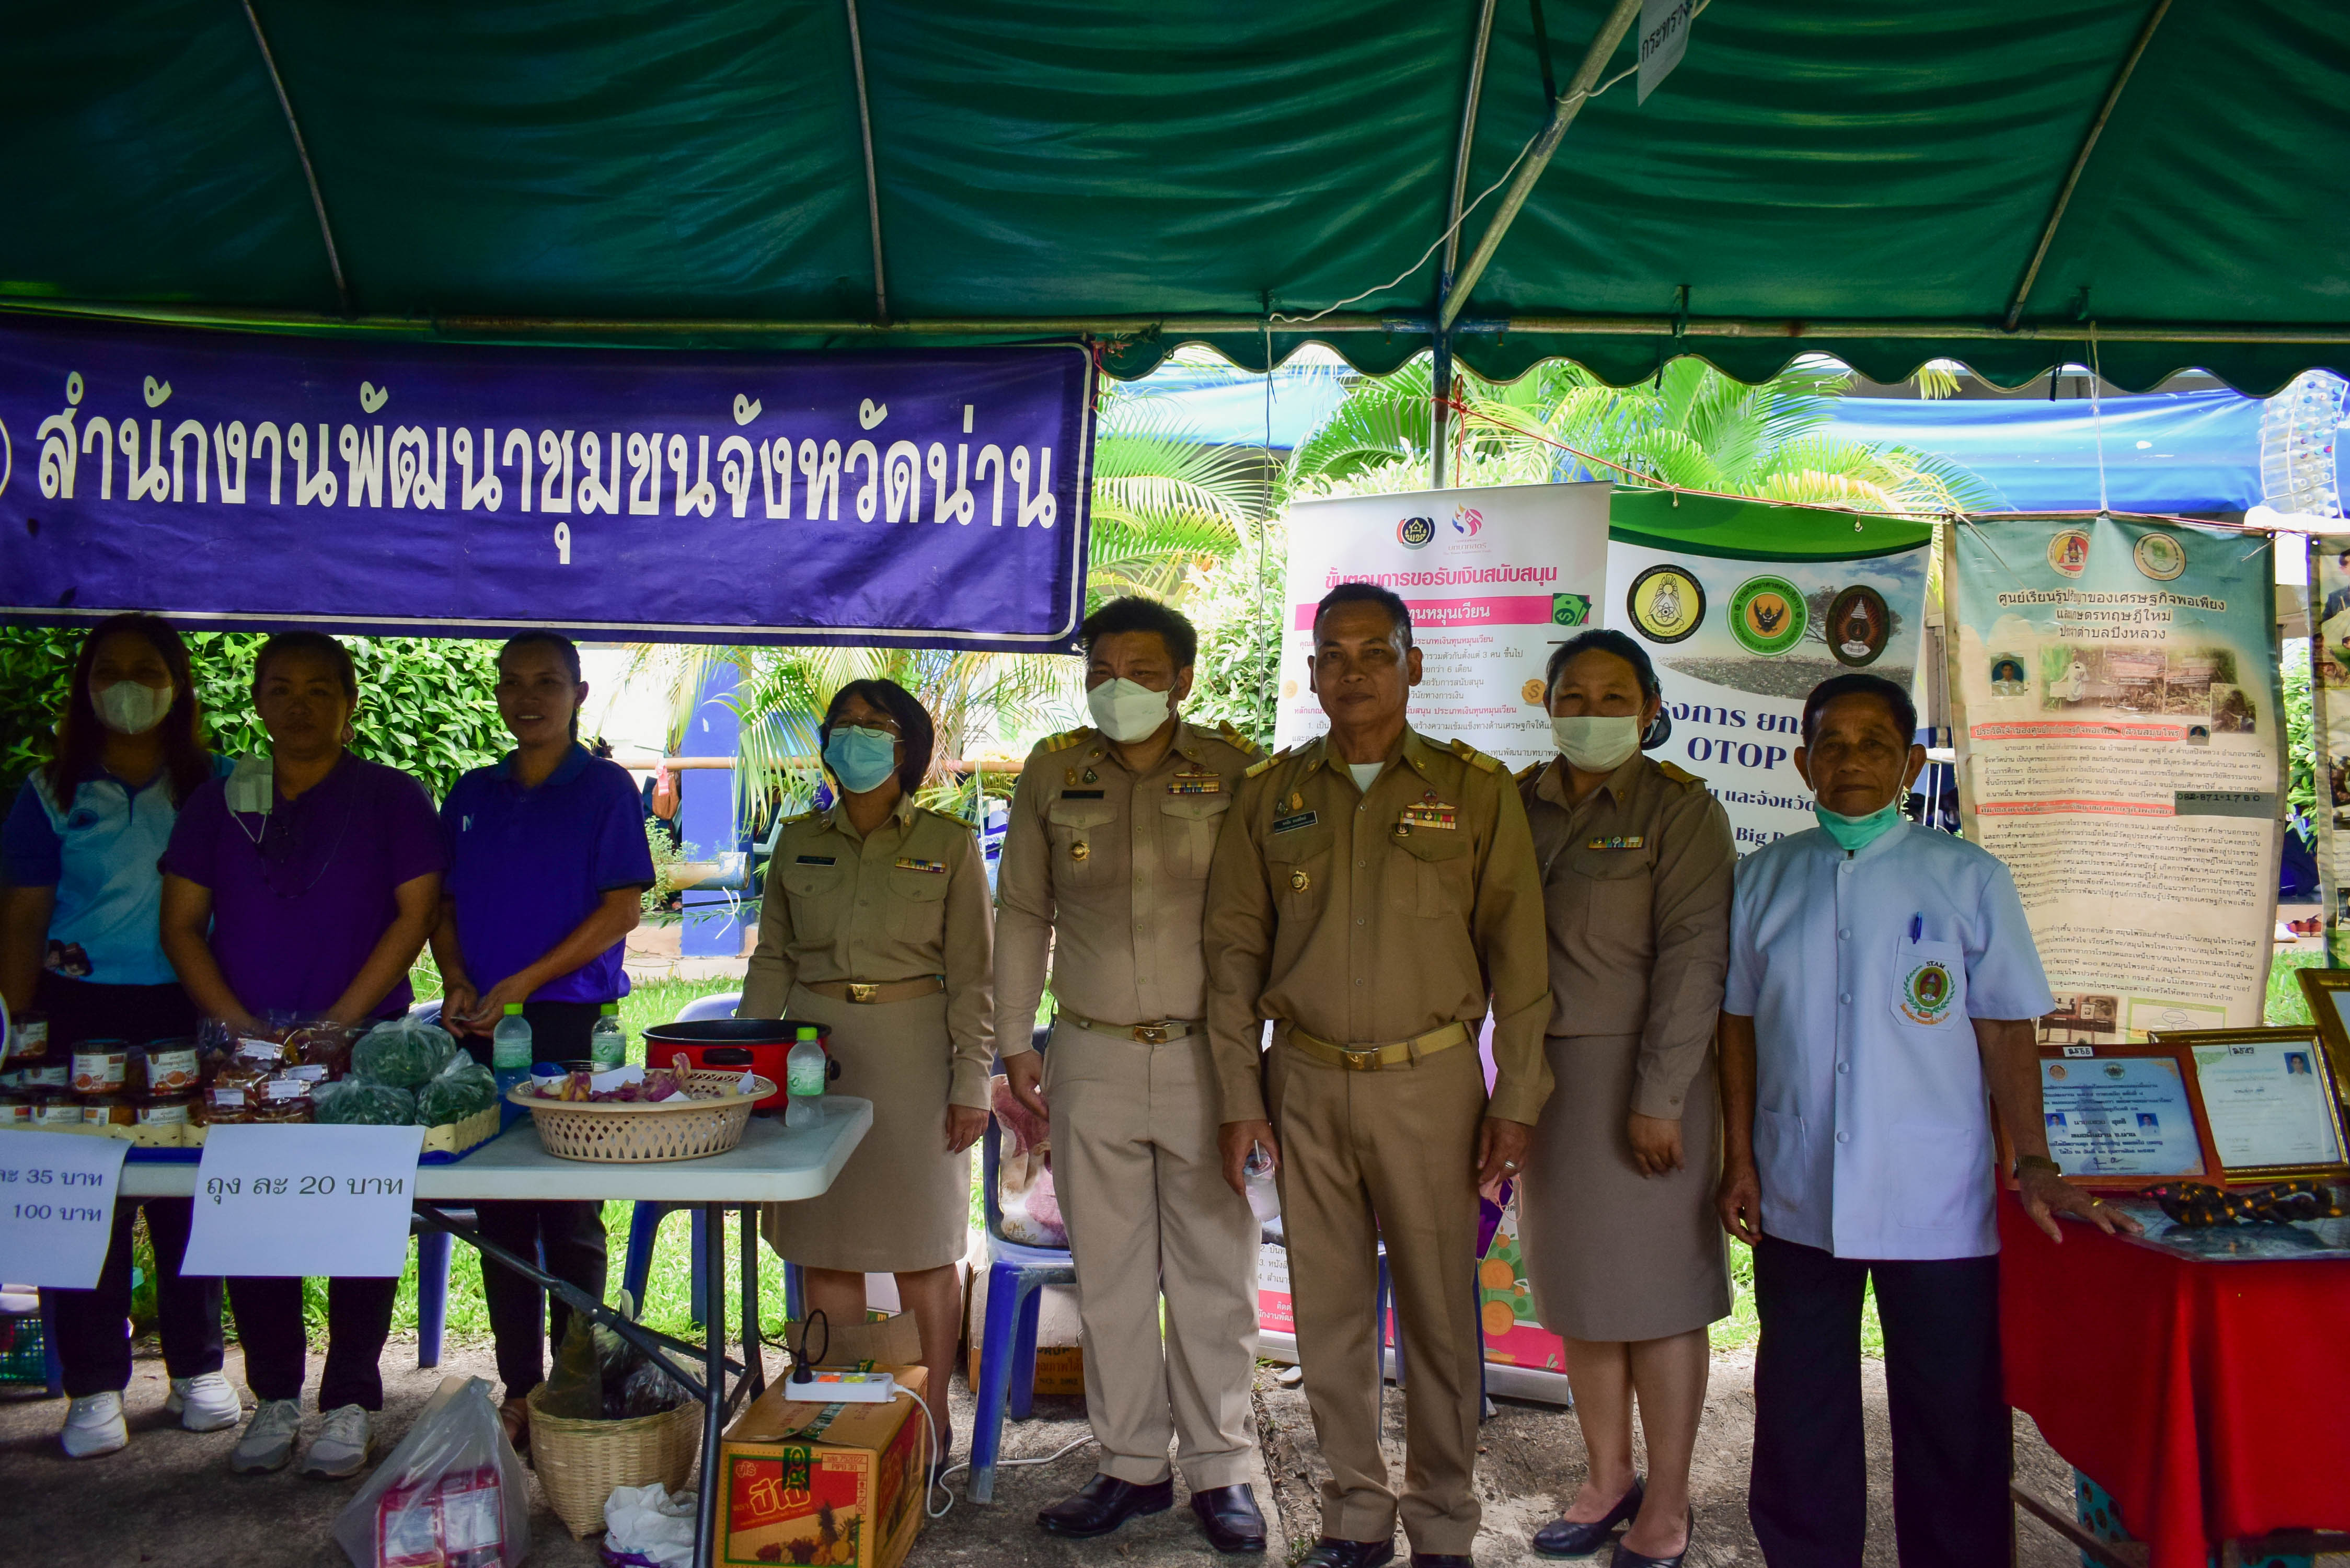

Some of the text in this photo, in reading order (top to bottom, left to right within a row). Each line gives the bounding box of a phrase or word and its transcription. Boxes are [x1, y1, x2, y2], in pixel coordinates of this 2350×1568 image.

[36, 371, 1057, 564] สำนักงานพัฒนาชุมชนจังหวัดน่าน
[1504, 647, 1523, 658] ขึ้นไป
[1455, 664, 1472, 673] เดือน
[1757, 713, 1803, 735] ยก
[1687, 737, 1787, 770] OTOP
[1736, 827, 1767, 847] Big
[27, 1169, 53, 1184] 35
[62, 1171, 102, 1186] บาท
[207, 1177, 404, 1205] ถุง ละ 20 บาท
[13, 1204, 101, 1222] 100 บาท
